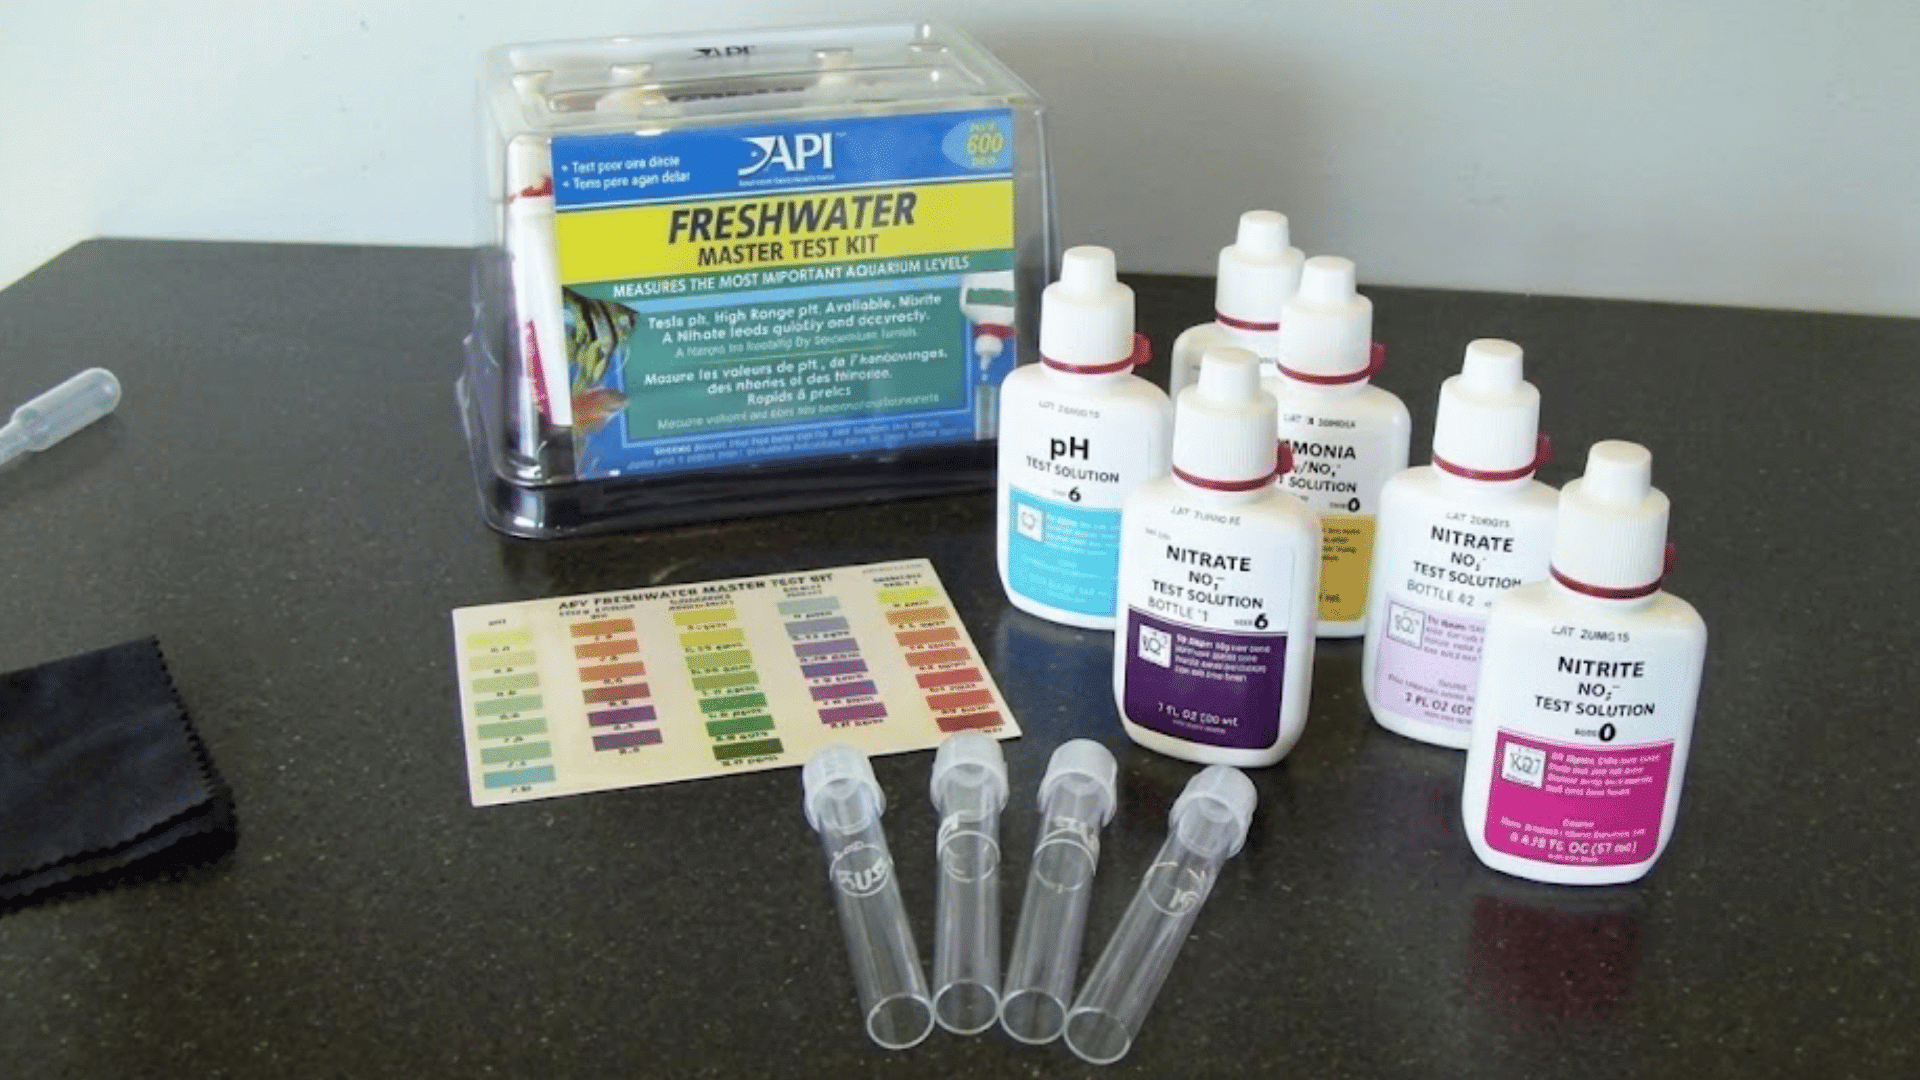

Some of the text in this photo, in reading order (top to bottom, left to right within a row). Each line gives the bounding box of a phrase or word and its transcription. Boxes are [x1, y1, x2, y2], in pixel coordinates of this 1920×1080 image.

[768, 132, 833, 172] API
[966, 132, 1004, 154] 600
[668, 191, 918, 244] FRESHWATER
[698, 233, 879, 266] MASTER TEST KIT
[613, 279, 686, 298] MEASURES
[690, 276, 716, 290] THE
[719, 273, 757, 289] MOST
[845, 260, 921, 278] AQUARIUM
[924, 255, 970, 272] LEVELS
[714, 310, 746, 327] High
[662, 331, 673, 344] A
[1050, 436, 1090, 461] pH
[1290, 440, 1357, 460] MONIA
[1026, 455, 1120, 483] TEST SOLUTION
[1068, 486, 1081, 502] 6
[1289, 476, 1357, 493] SOLUTION
[1430, 525, 1514, 552] NITRATE
[1166, 545, 1251, 572] NITRATE
[1413, 560, 1522, 590] TEST SOLUTION
[1152, 579, 1263, 609] TEST SOLUTION
[1407, 579, 1454, 603] BOTTLE
[1148, 596, 1193, 620] BOTTLE
[1254, 613, 1268, 630] 6
[1558, 656, 1646, 679] NITRITE
[1534, 695, 1656, 718] TEST SOLUTION
